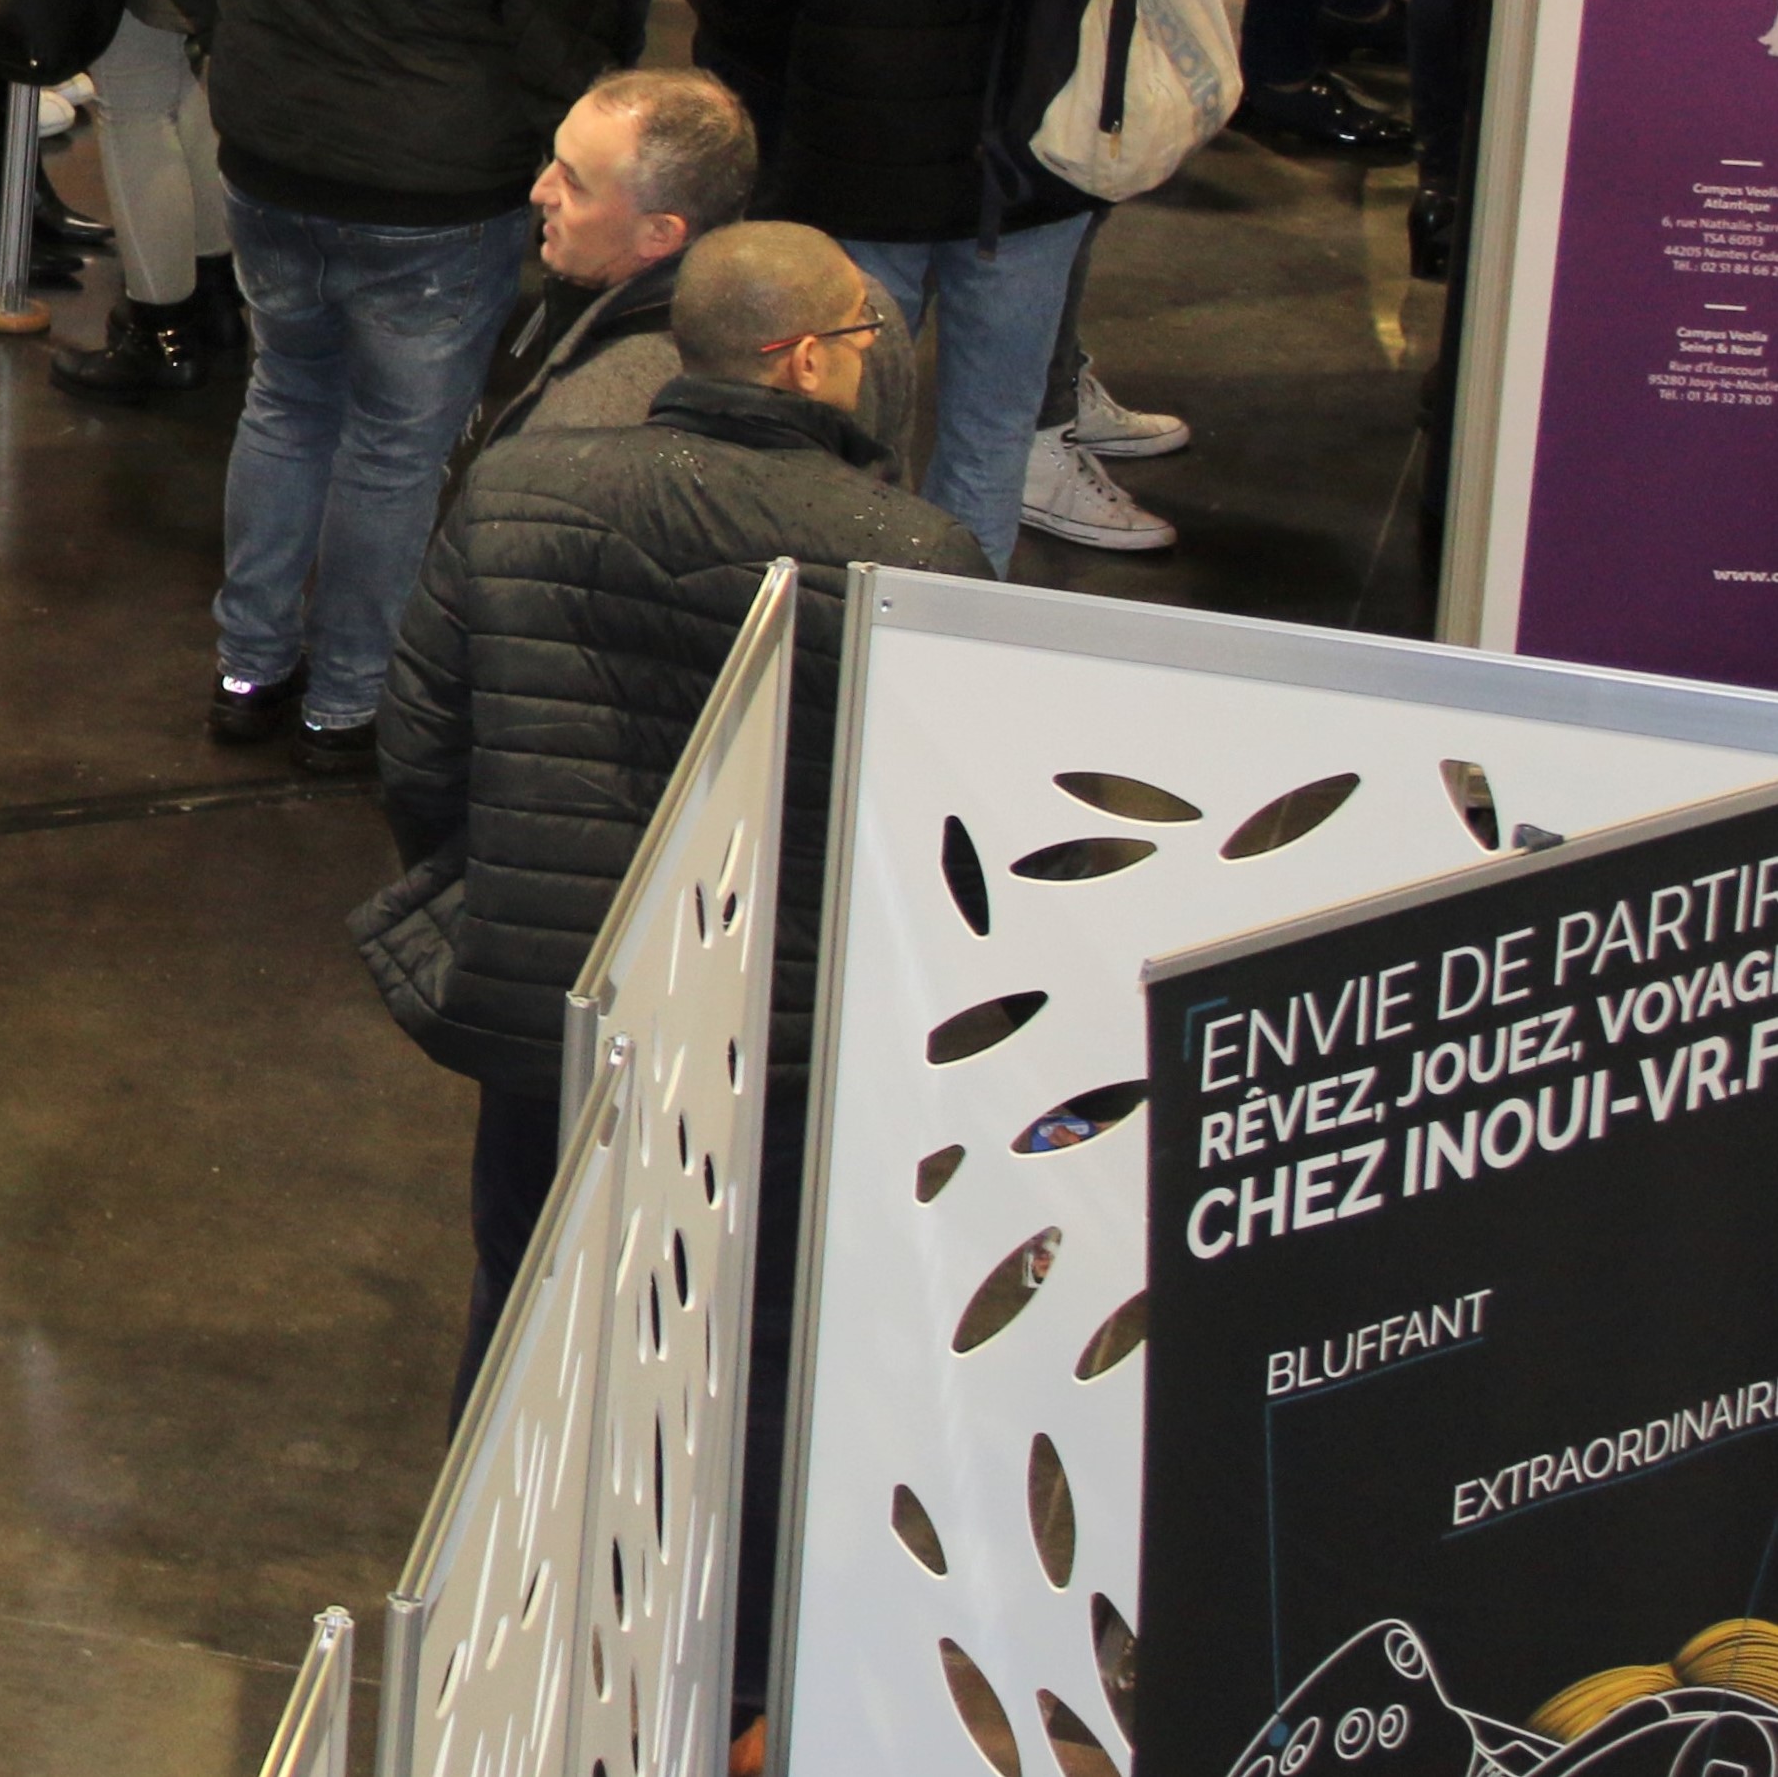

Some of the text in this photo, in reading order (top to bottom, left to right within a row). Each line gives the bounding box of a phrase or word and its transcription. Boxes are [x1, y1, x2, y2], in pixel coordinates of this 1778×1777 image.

[1703, 198, 1771, 213] Atlantique
[1198, 949, 1778, 1168] RÊVEZ, JOUEZ, VOYAG
[1200, 961, 1419, 1093] ENVIE
[1438, 926, 1537, 1021] DE
[1185, 1138, 1389, 1260] CHEZ
[1266, 1289, 1493, 1396] BLUFFANT
[1452, 1377, 1778, 1526] EXTRAORDINAIR
